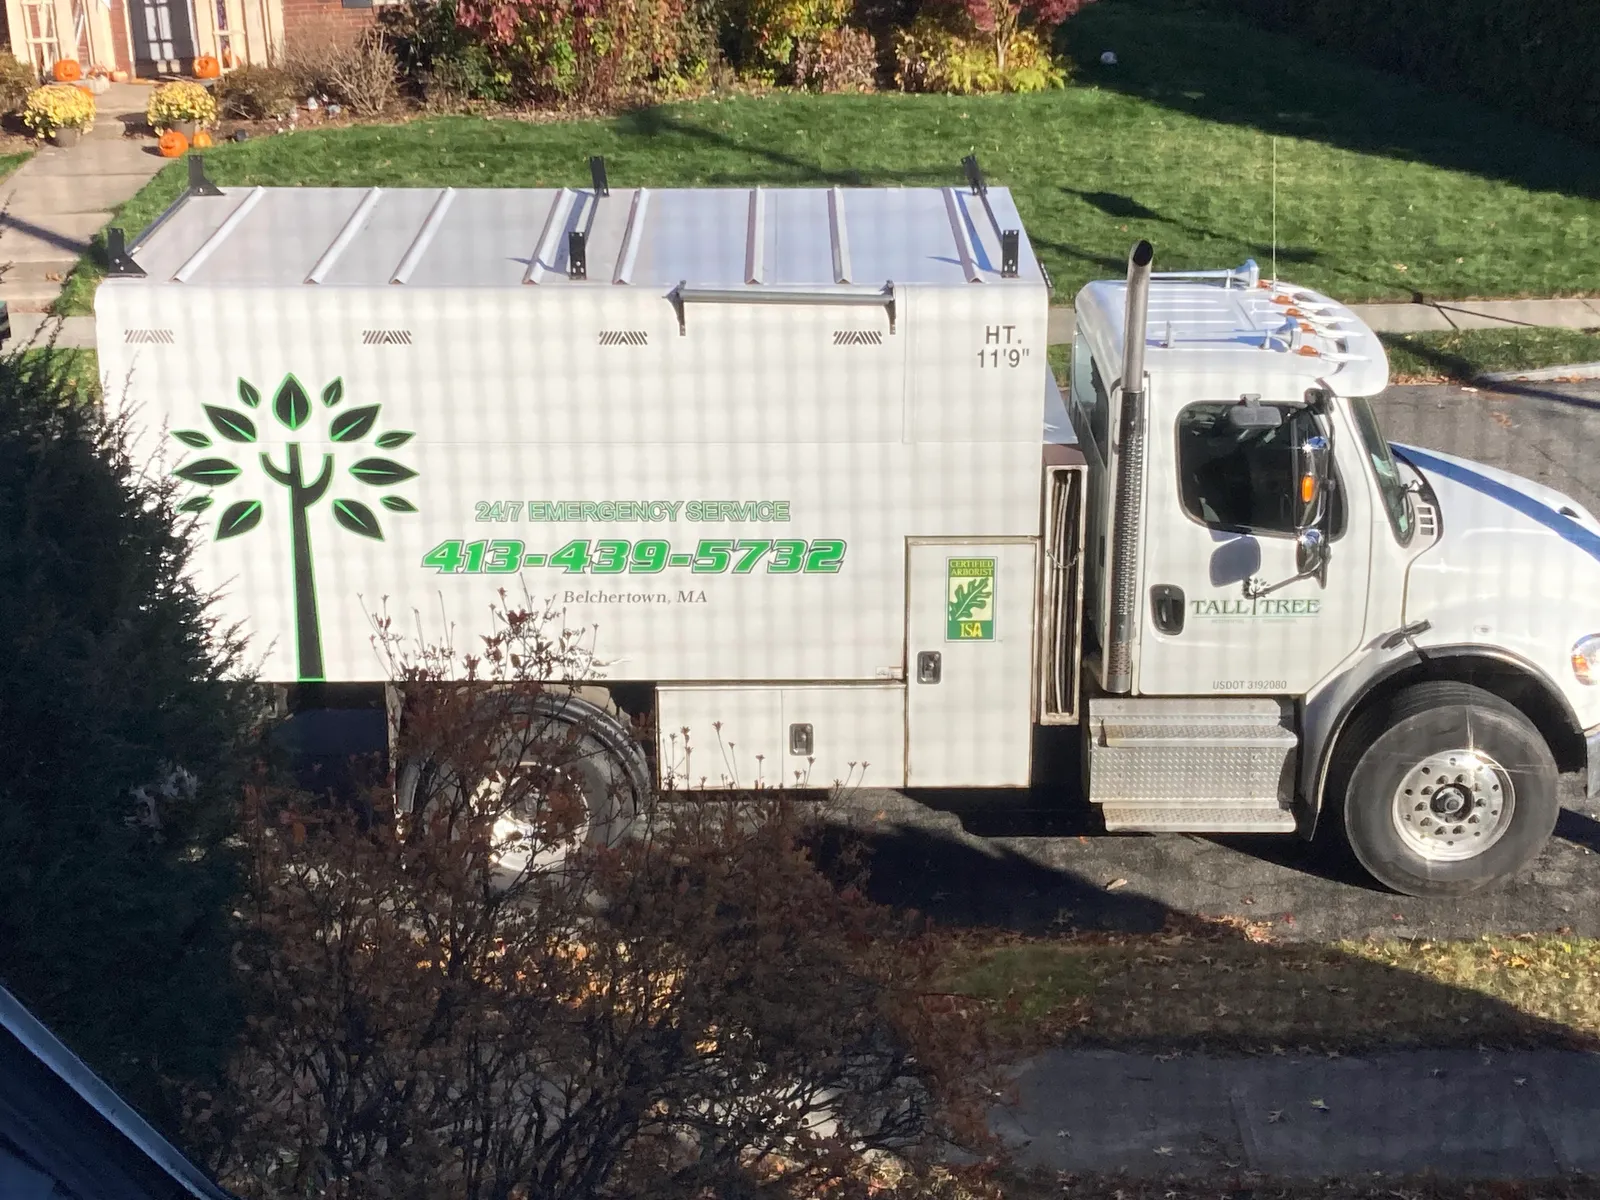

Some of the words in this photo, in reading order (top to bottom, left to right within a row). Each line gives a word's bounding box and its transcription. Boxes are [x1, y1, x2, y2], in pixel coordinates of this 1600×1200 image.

[985, 325, 1022, 345] HT.
[977, 348, 1030, 368] 11'9"
[475, 500, 524, 522] 24/7
[528, 500, 684, 522] EMERGENCY
[685, 500, 791, 522] SERVICE
[421, 538, 847, 575] 413-439-5732
[949, 560, 994, 568] CERTIFIED
[950, 568, 994, 576] ARBORIST
[563, 590, 671, 605] Belchertown,
[676, 590, 708, 603] MA
[1190, 599, 1250, 615] TALL
[1259, 599, 1322, 615] TREE
[960, 622, 983, 638] ISA
[1212, 680, 1246, 690] USDOT
[1247, 680, 1288, 690] 3192080
